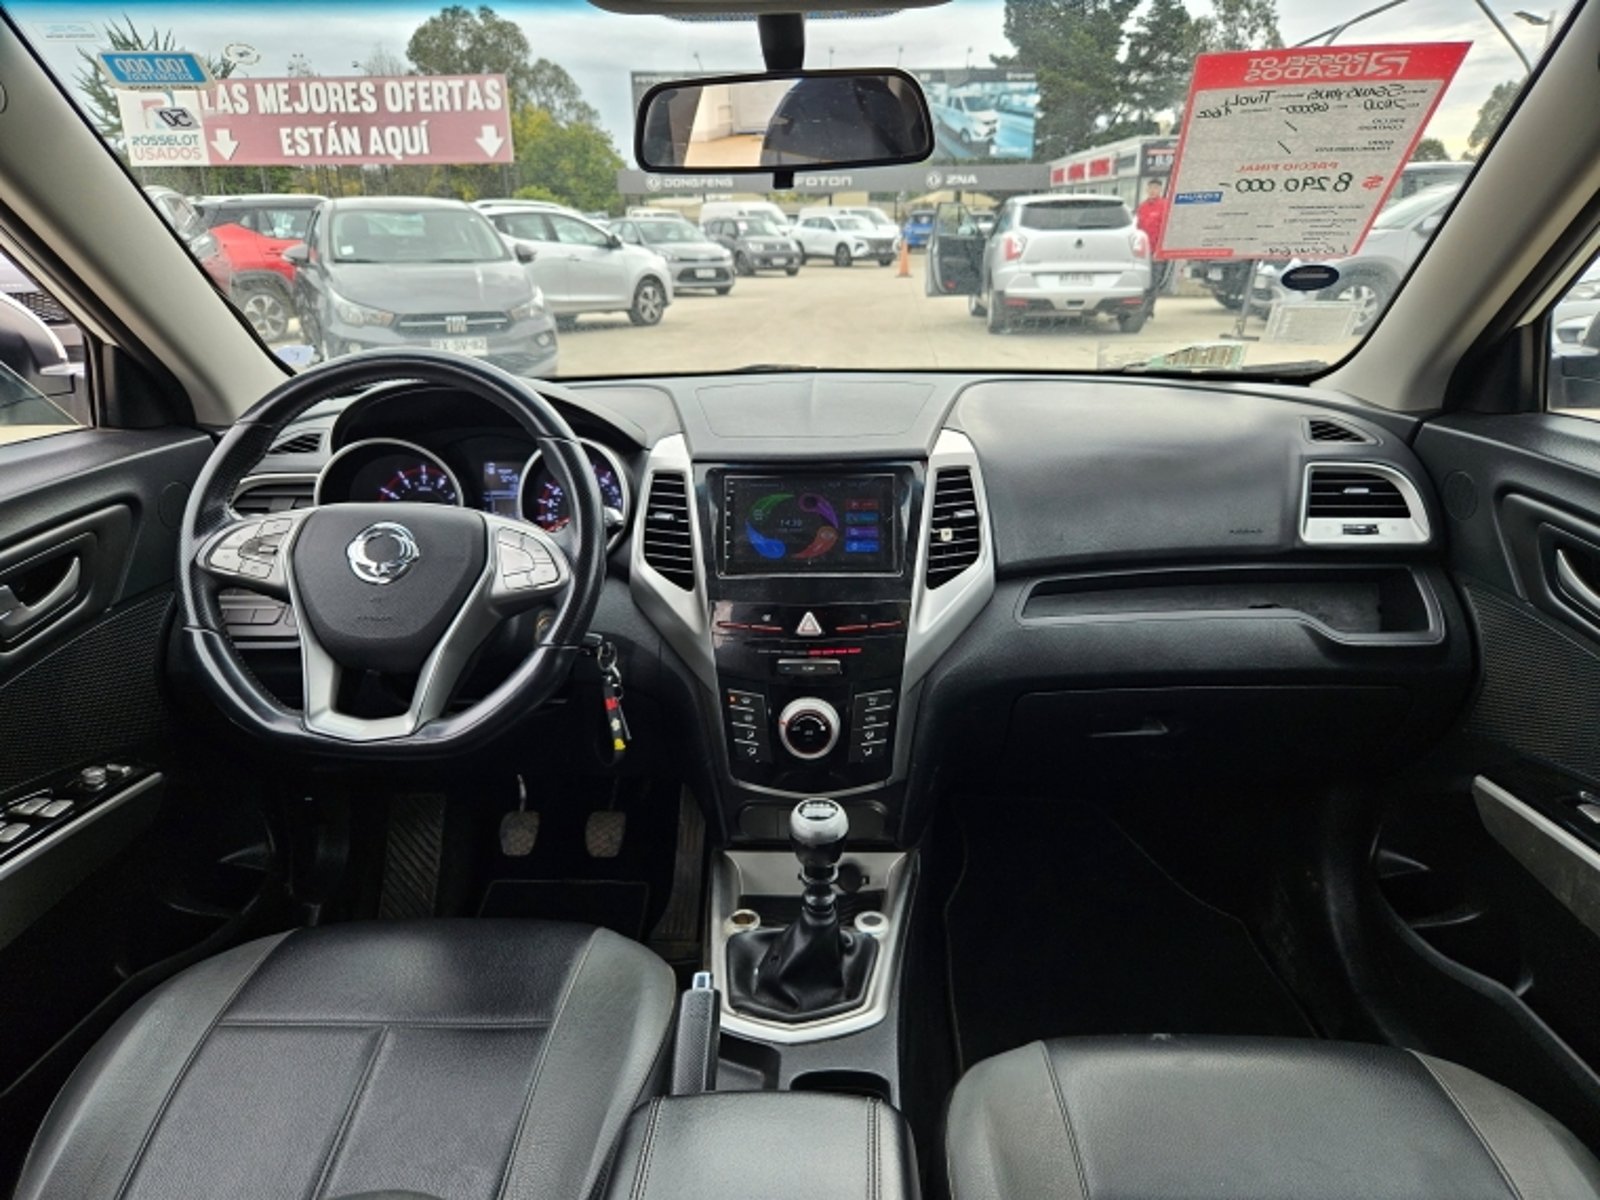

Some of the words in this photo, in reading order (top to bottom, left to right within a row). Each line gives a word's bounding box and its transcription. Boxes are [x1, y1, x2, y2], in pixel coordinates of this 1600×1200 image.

[203, 83, 249, 115] LAS
[255, 81, 376, 114] MEJORES
[384, 78, 502, 112] OFERTAS
[131, 134, 199, 147] ROSSELOT
[280, 121, 365, 157] ESTÁN
[369, 120, 430, 160] AQUÍ
[134, 147, 202, 160] USADOS
